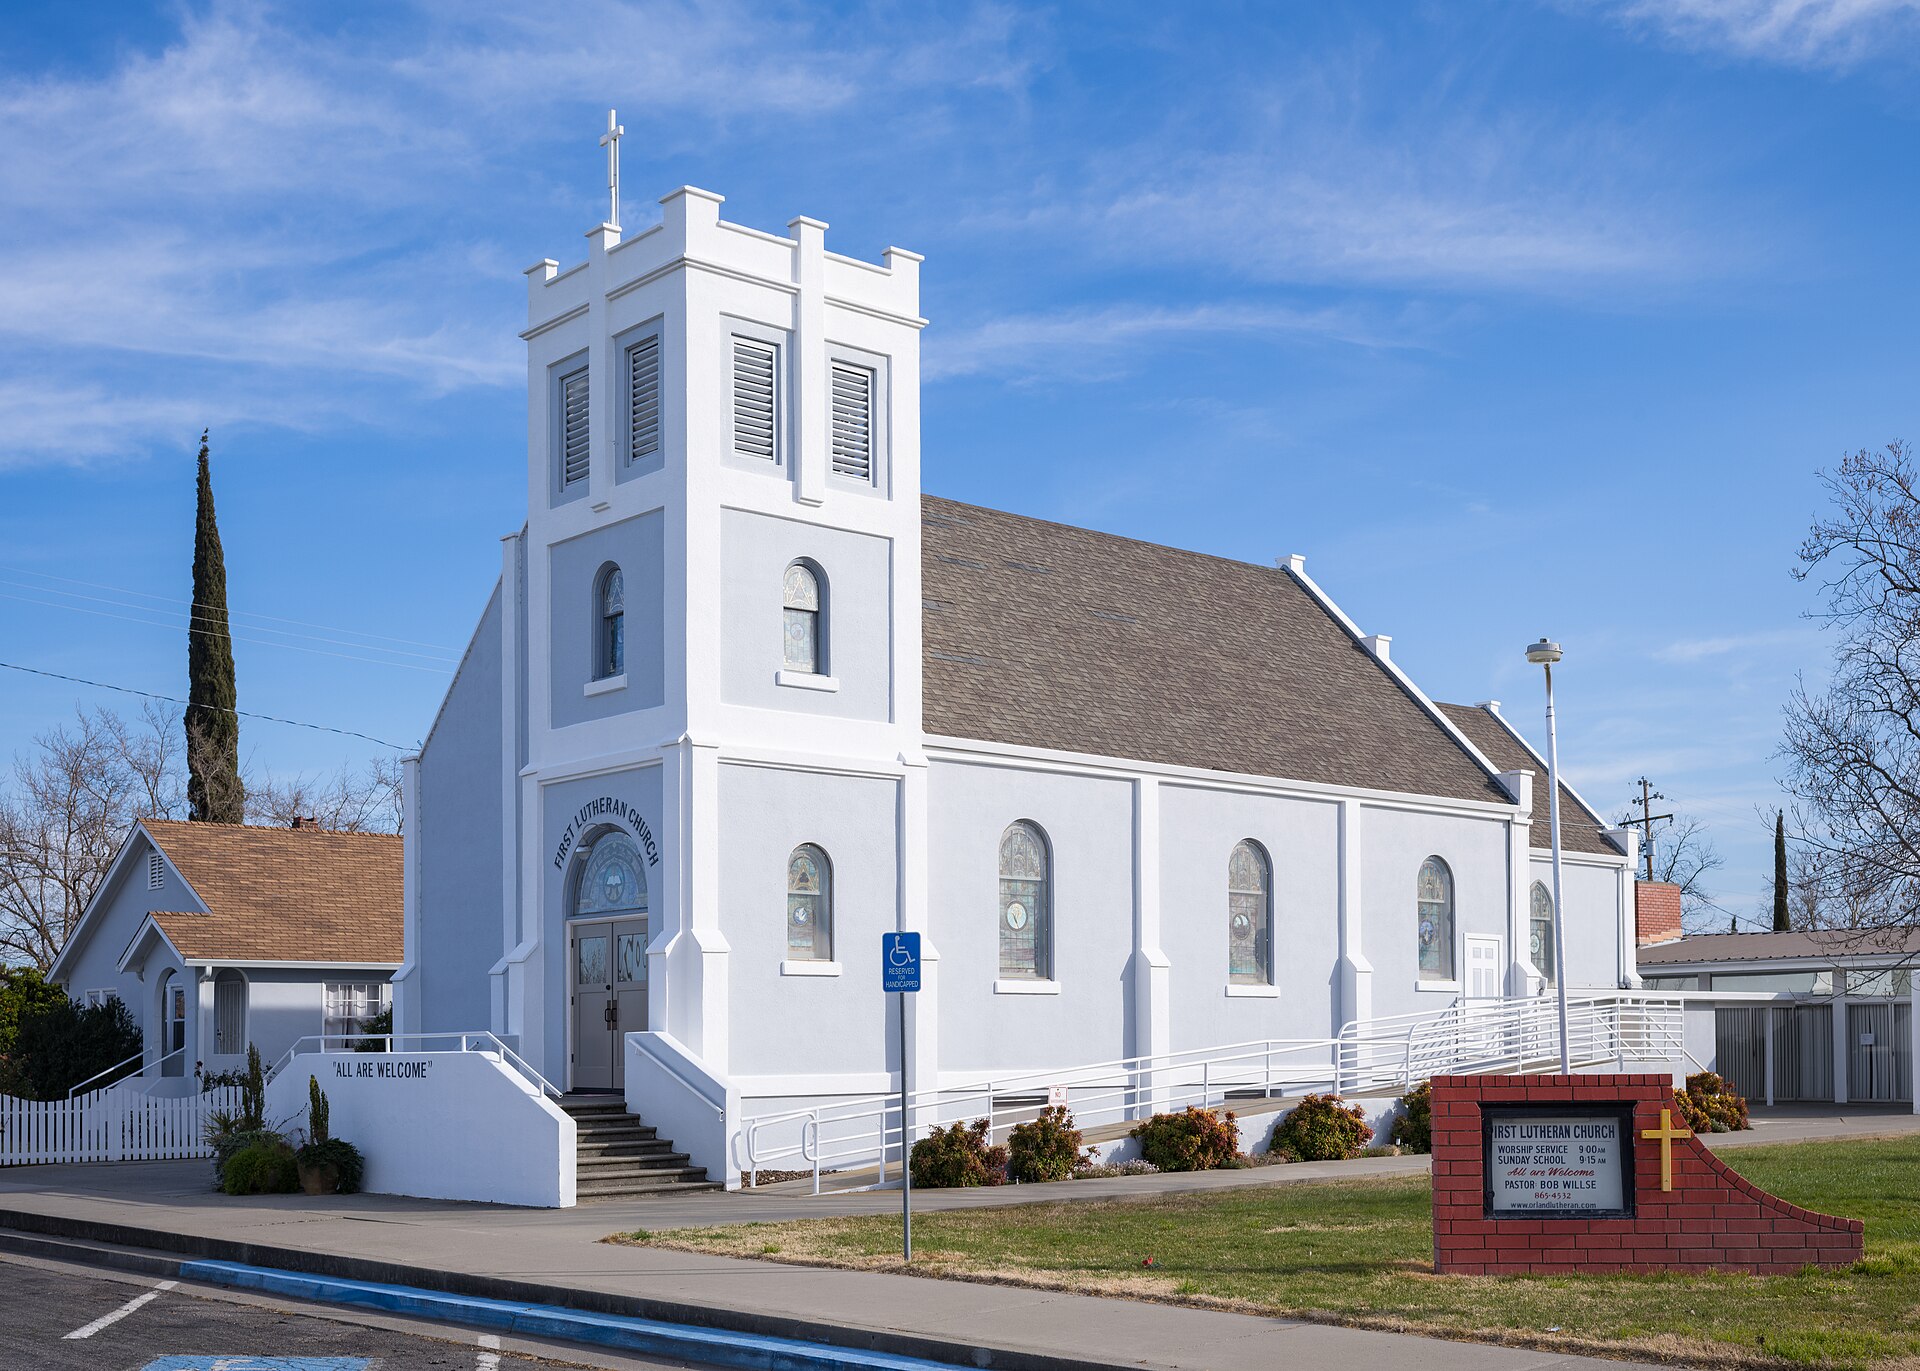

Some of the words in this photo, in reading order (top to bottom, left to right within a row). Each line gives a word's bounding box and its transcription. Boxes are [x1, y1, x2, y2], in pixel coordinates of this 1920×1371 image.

[554, 823, 575, 870] FIRST
[574, 797, 628, 829] LUTHERAN
[628, 808, 660, 867] CHURCH
[888, 967, 915, 975] RESERVED
[885, 980, 919, 988] HANDICAPPED
[356, 1062, 374, 1078] ARE
[1492, 1124, 1517, 1139] IRST
[1519, 1124, 1571, 1139] LUTHERAN
[1573, 1124, 1615, 1139] CHURCH
[1497, 1145, 1534, 1154] WORSHIP
[1535, 1145, 1568, 1154] SERVICE
[1497, 1155, 1531, 1165] SUNDAY
[1533, 1155, 1566, 1165] SCHOOL
[1507, 1167, 1527, 1177] All
[1529, 1169, 1546, 1177] are
[1547, 1167, 1595, 1177] Welcome
[1540, 1180, 1559, 1190] BOB
[1562, 1180, 1597, 1190] WILLSE
[1510, 1201, 1597, 1209] www.orlandlutheran.com
